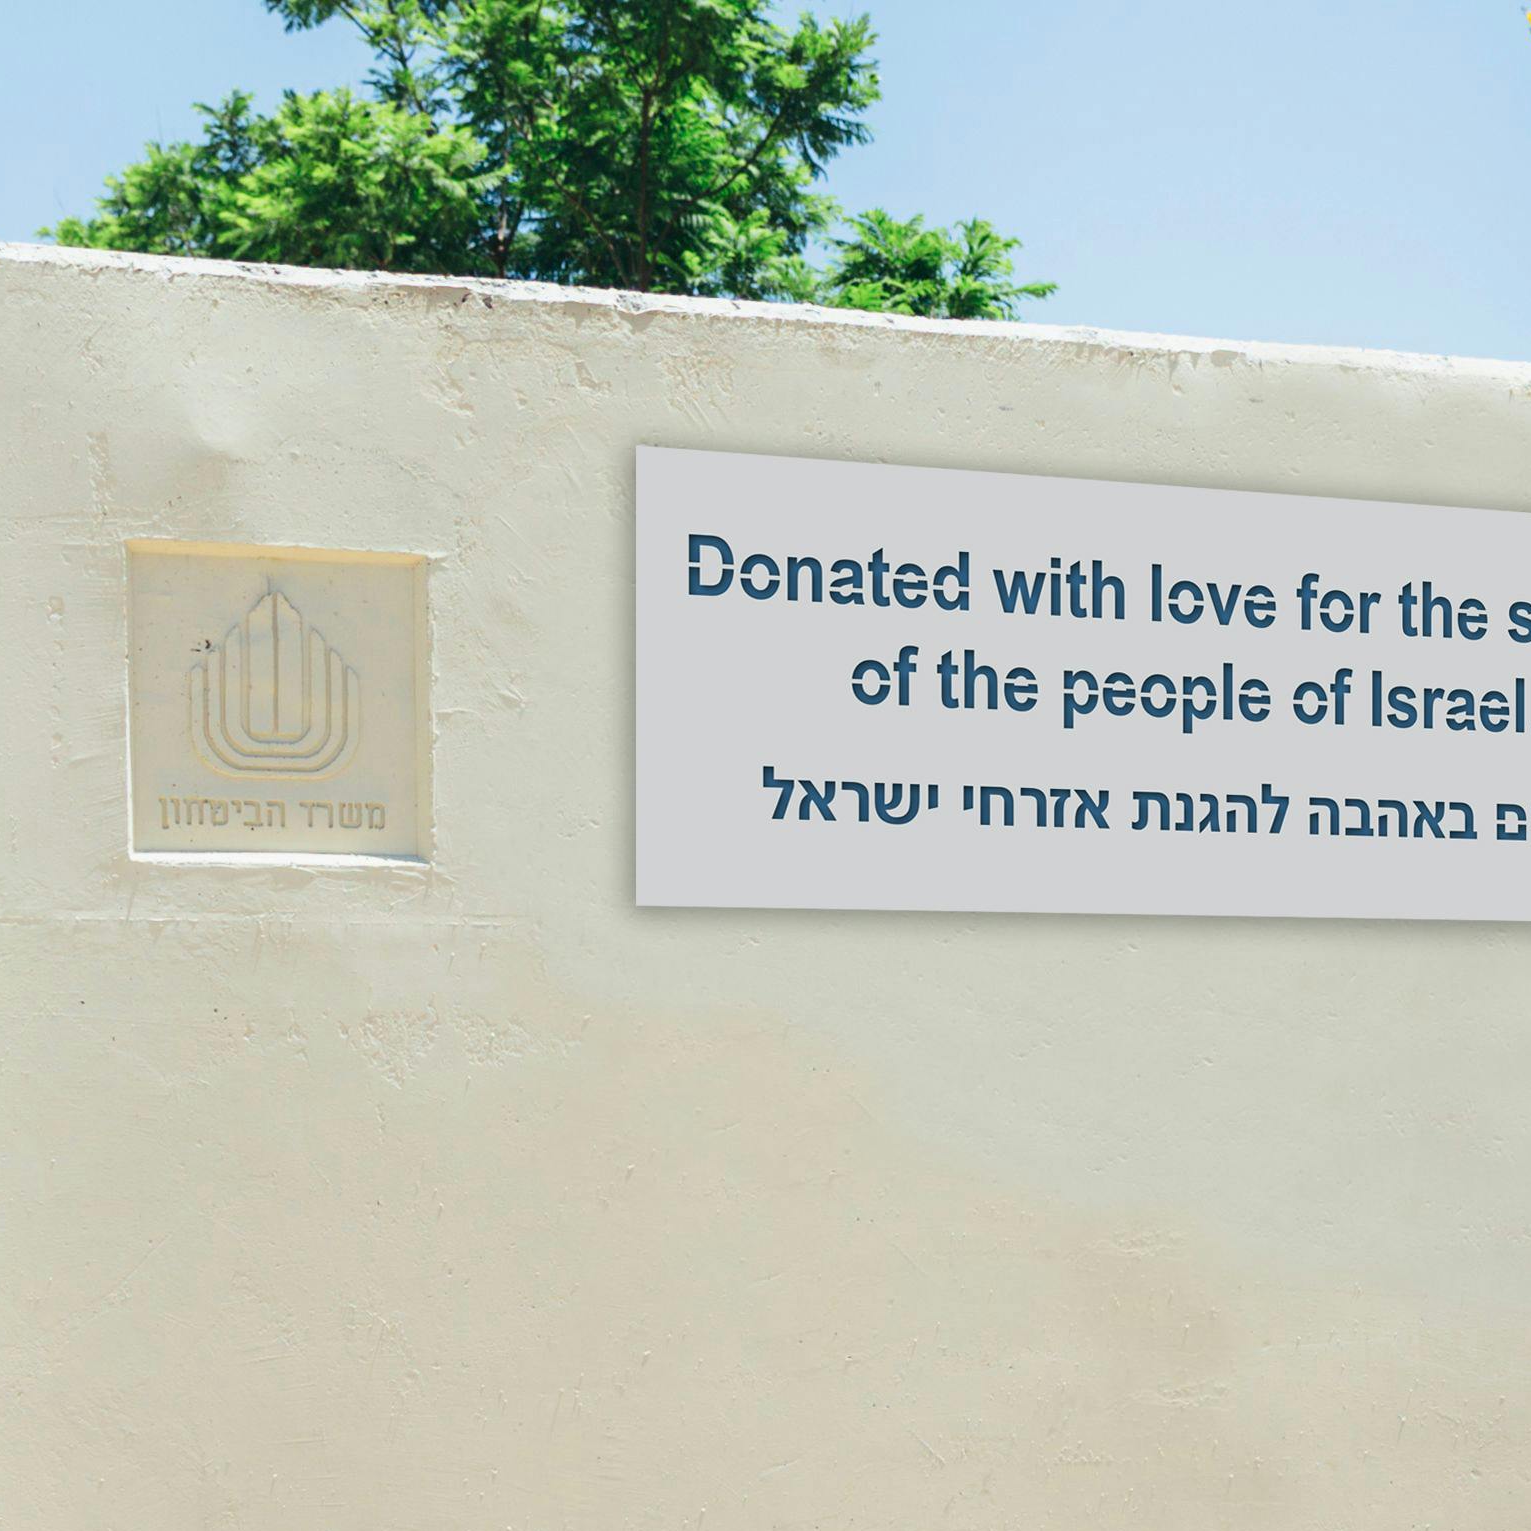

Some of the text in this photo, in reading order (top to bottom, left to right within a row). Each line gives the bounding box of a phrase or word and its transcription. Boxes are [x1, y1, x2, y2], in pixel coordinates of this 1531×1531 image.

[687, 533, 971, 616] Donated
[993, 557, 1125, 622] with
[1151, 563, 1279, 631] love
[1295, 572, 1385, 636] for
[1398, 581, 1489, 642] the
[851, 645, 919, 707] of
[937, 649, 1039, 713] the
[1062, 662, 1274, 734] people
[1292, 668, 1354, 727] of
[158, 795, 388, 830] משרד הביטחון
[761, 766, 940, 826] ישראל
[963, 785, 1110, 830] אזרחי
[1131, 783, 1291, 834] להגנת
[1309, 797, 1479, 840] באהבה
